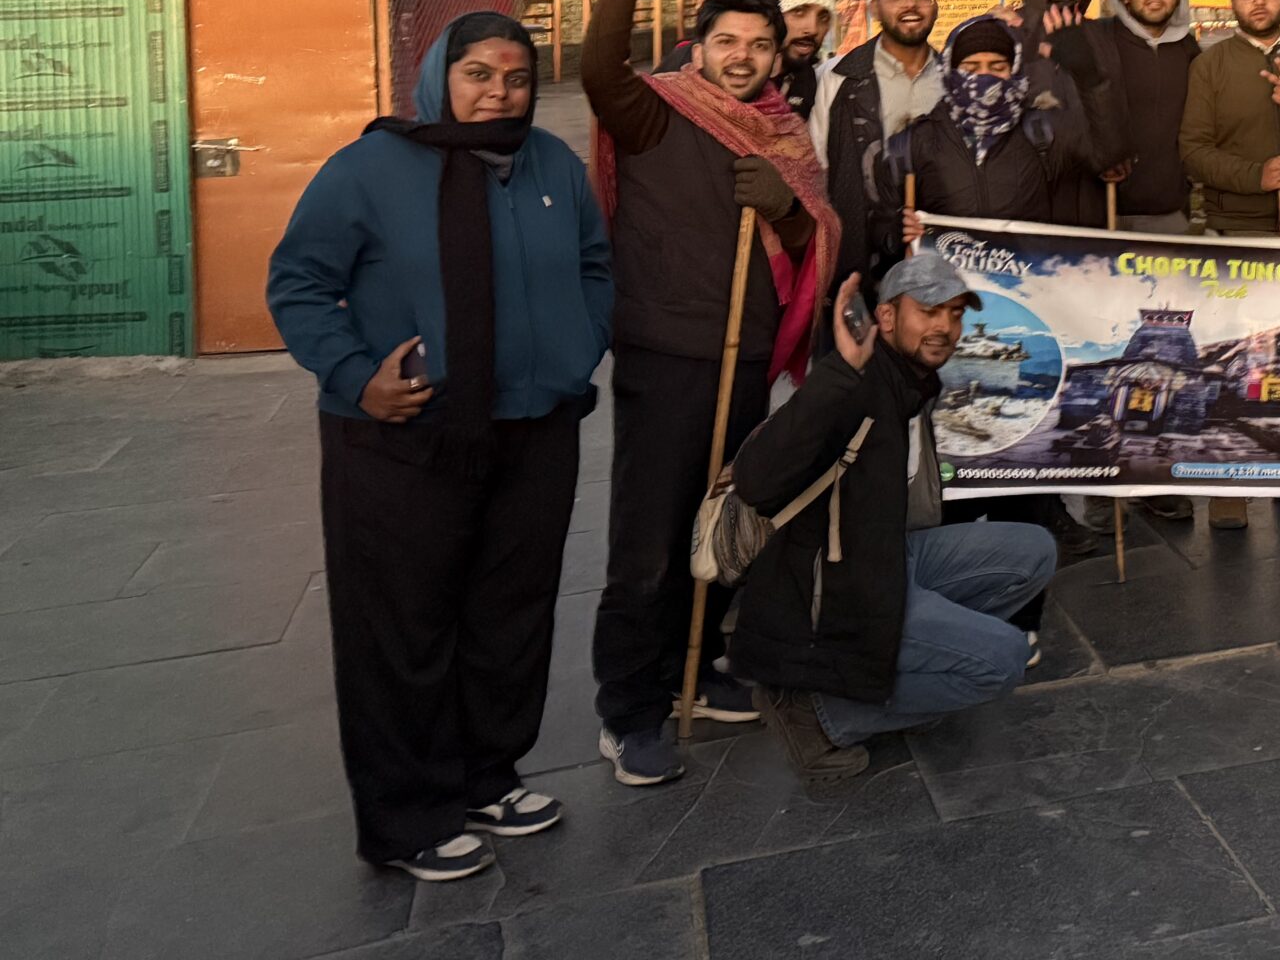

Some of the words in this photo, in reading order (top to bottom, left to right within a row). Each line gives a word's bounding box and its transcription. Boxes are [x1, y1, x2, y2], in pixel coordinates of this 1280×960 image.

[0, 215, 44, 233] ndal
[943, 253, 1033, 277] OLIDAY
[1117, 252, 1218, 280] CHOPTA
